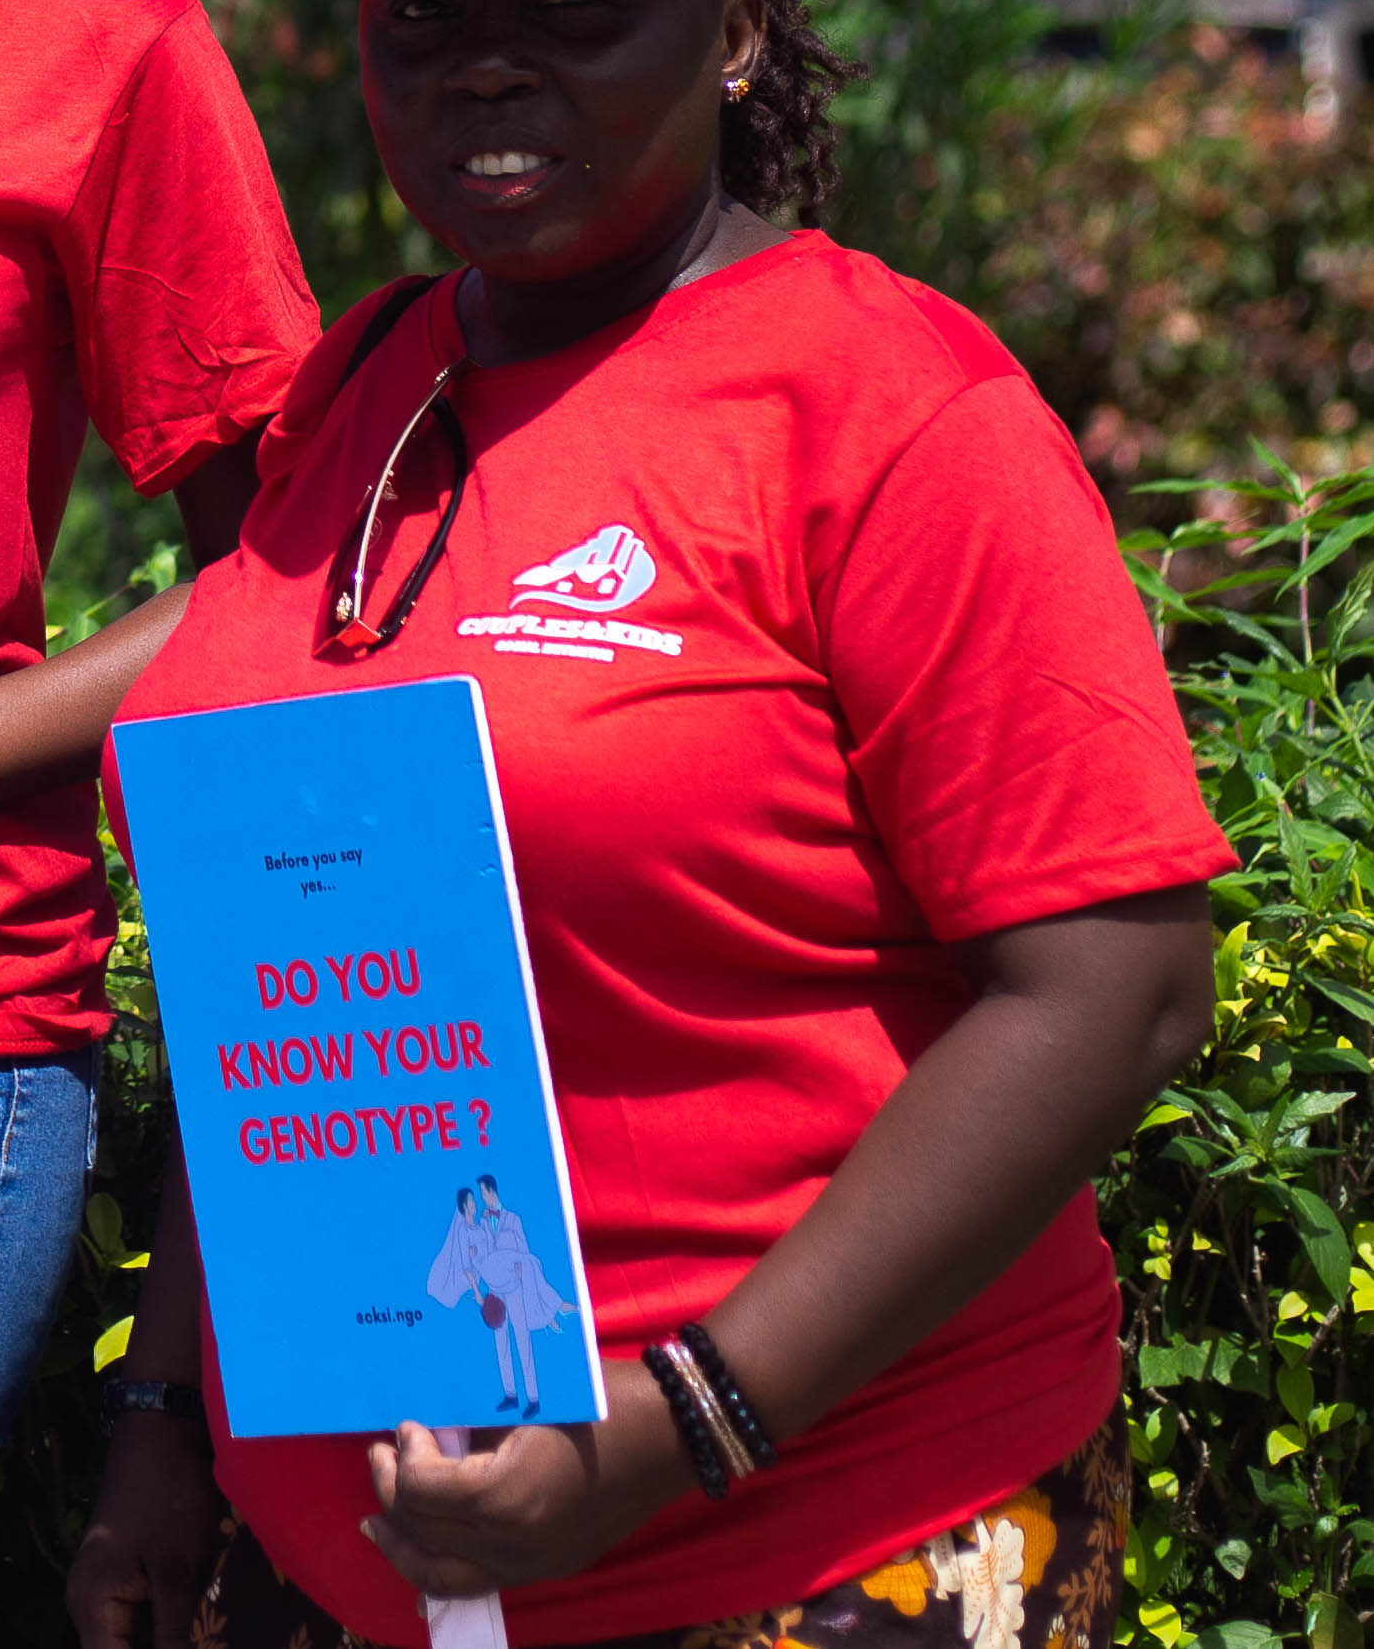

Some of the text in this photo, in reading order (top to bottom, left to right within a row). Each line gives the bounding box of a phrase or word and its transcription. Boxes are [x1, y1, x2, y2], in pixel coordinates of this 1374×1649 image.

[264, 848, 362, 871] Before you say
[300, 880, 336, 900] yes...
[255, 947, 421, 1011] DO YOU
[218, 1020, 491, 1091] KNOW YOUR
[239, 1101, 461, 1166] GENOTYPE
